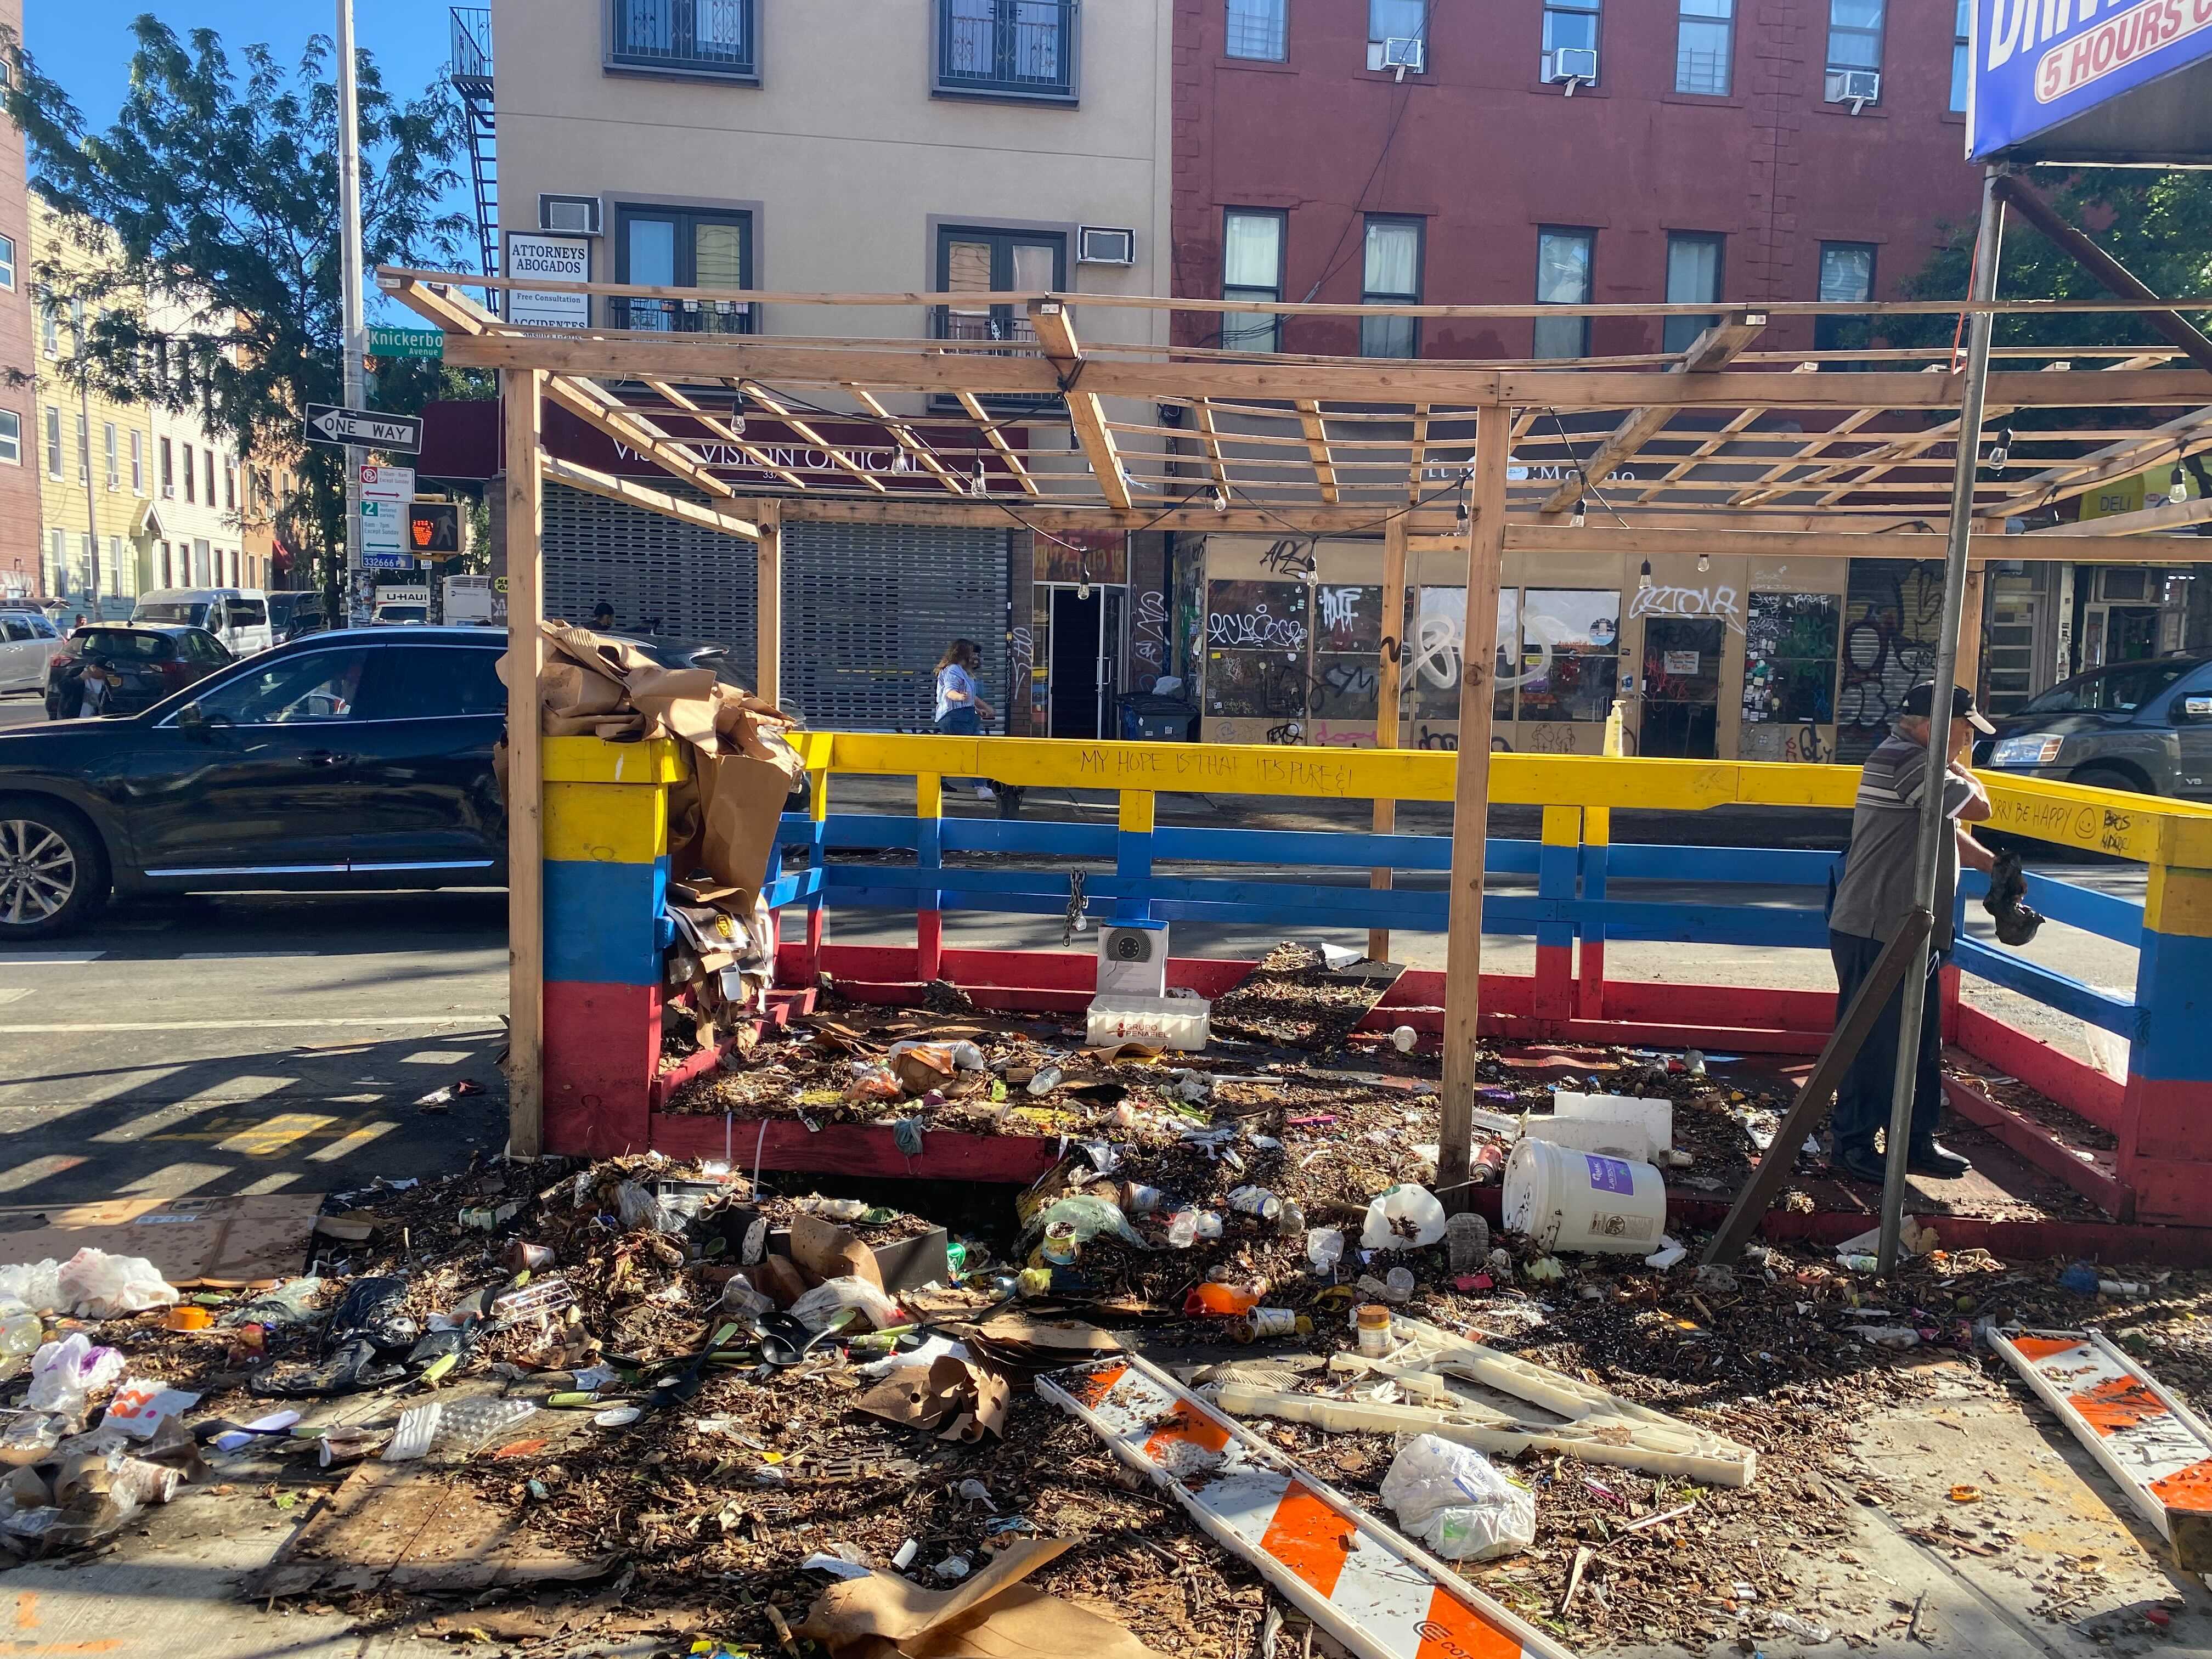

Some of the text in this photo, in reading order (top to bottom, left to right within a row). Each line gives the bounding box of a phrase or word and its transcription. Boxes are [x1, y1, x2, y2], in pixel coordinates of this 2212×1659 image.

[2043, 53, 2063, 97] 5
[2069, 0, 2182, 86] HOURS
[512, 244, 585, 259] ATTORNEYS
[516, 258, 580, 273] ABOGADOS
[535, 294, 580, 303] Consultation
[409, 347, 438, 356] Avenue
[324, 417, 407, 441] ONE WAY
[805, 450, 925, 472] OTICL
[365, 501, 374, 516] 2
[2100, 495, 2131, 511] DELI
[364, 557, 394, 567] 332666
[1080, 749, 1109, 773] MY
[1118, 751, 1167, 774] HOPE
[1176, 752, 1190, 774] IS
[1990, 797, 2073, 837] ORRY BE HAPPY
[1126, 1023, 1158, 1032] GRUPO
[1604, 1158, 1616, 1190] LAVEN
